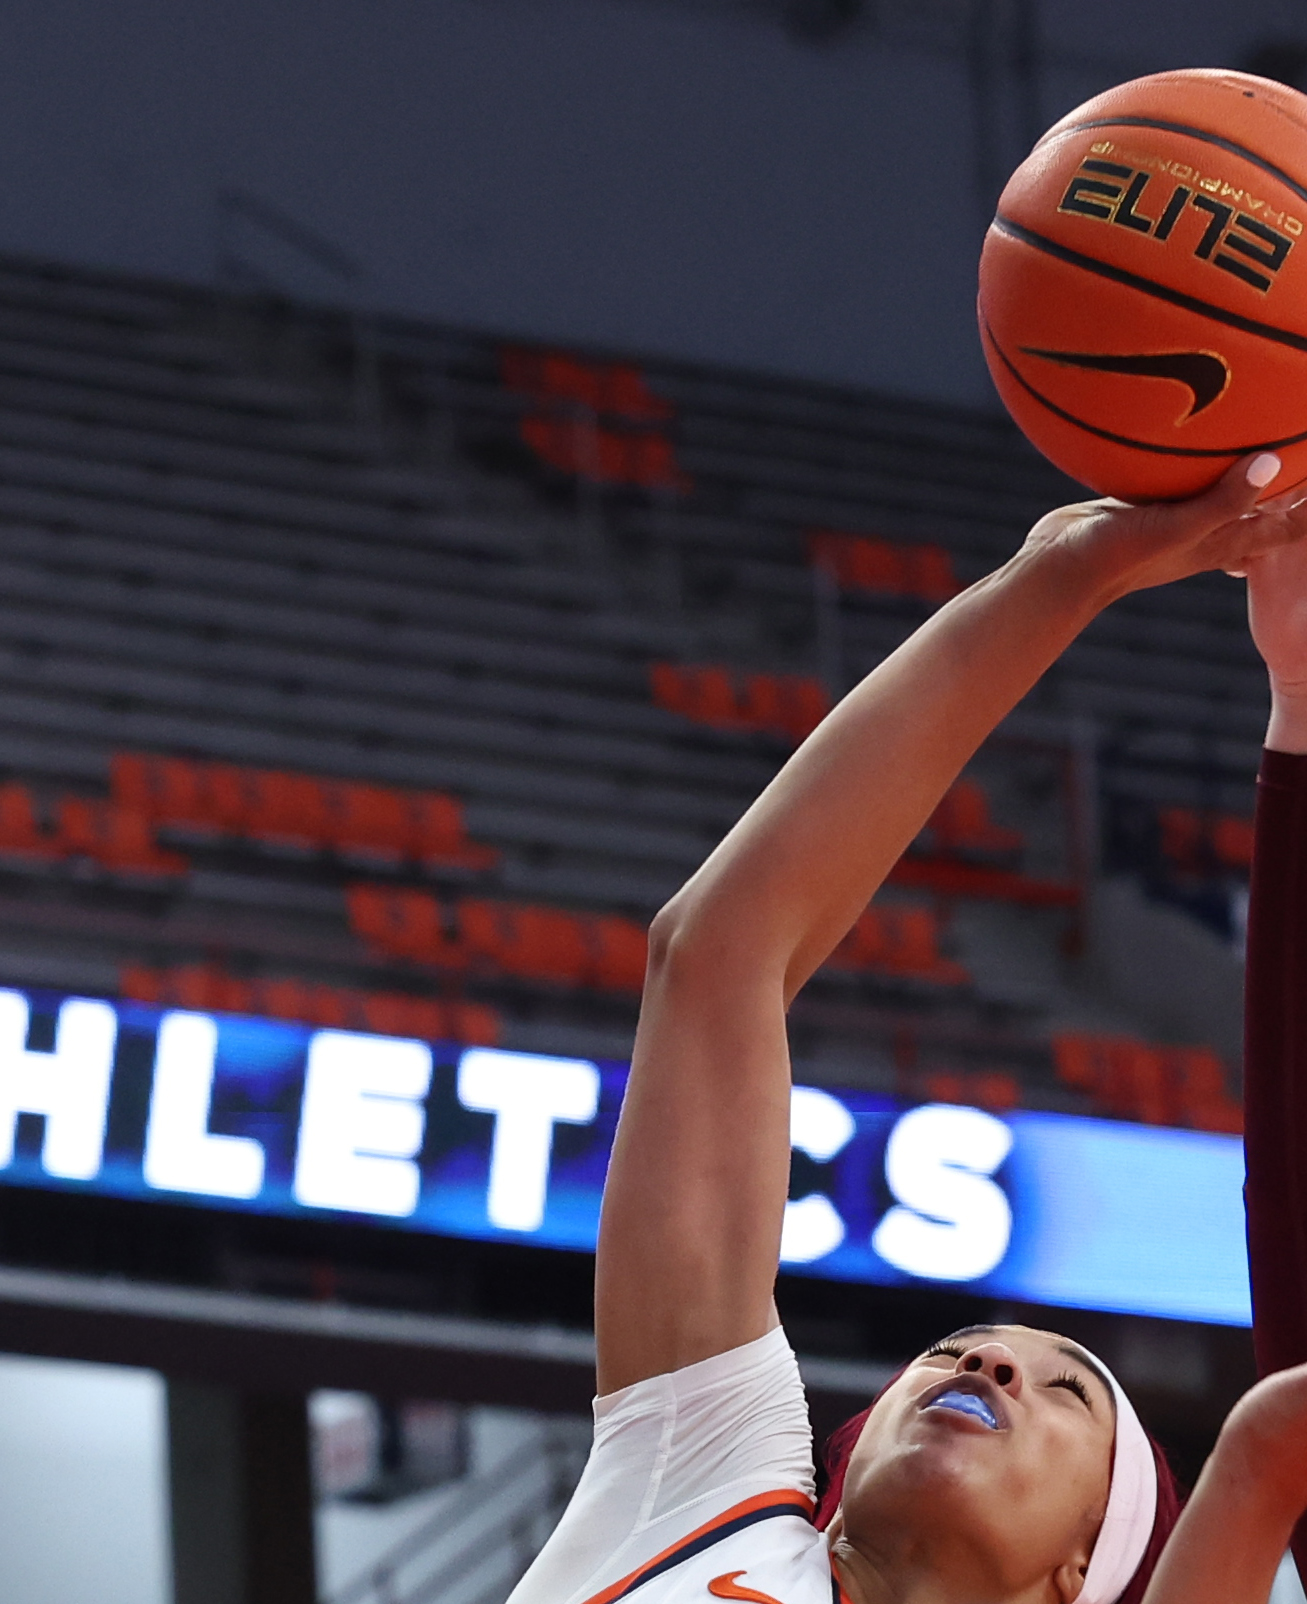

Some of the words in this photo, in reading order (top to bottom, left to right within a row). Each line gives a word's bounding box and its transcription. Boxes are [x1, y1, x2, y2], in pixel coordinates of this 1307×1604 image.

[1057, 155, 1297, 294] ELITE
[1089, 141, 1303, 236] CHAMPIONIP
[0, 986, 1016, 1283] HLETCS
